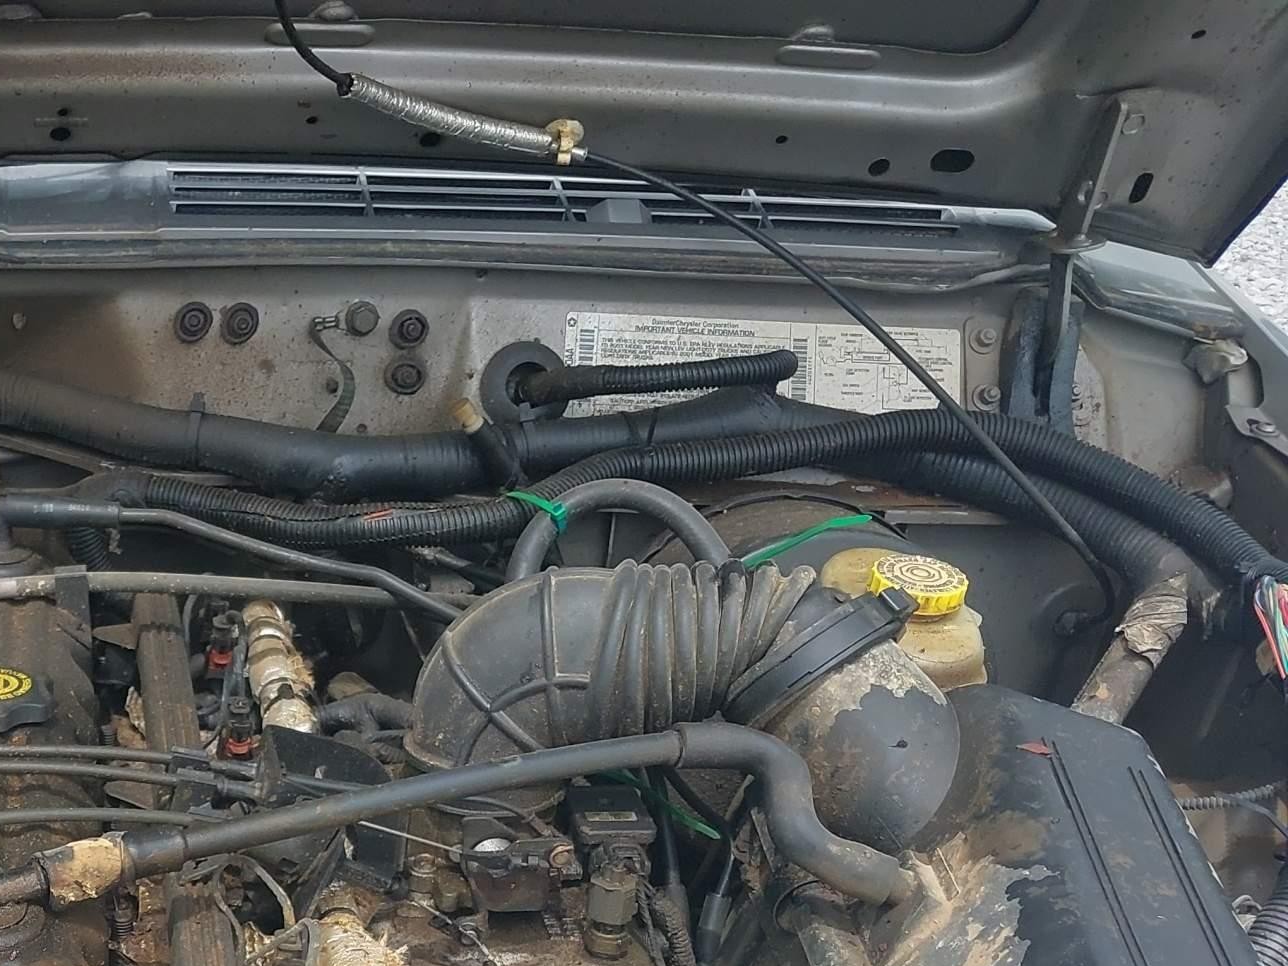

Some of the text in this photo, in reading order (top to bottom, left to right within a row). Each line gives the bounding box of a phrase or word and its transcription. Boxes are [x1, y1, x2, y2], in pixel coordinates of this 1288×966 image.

[652, 318, 739, 329] DaimlerChrysler Corporation
[635, 324, 756, 337] IMPORTANT VEHICLE INFORMATION
